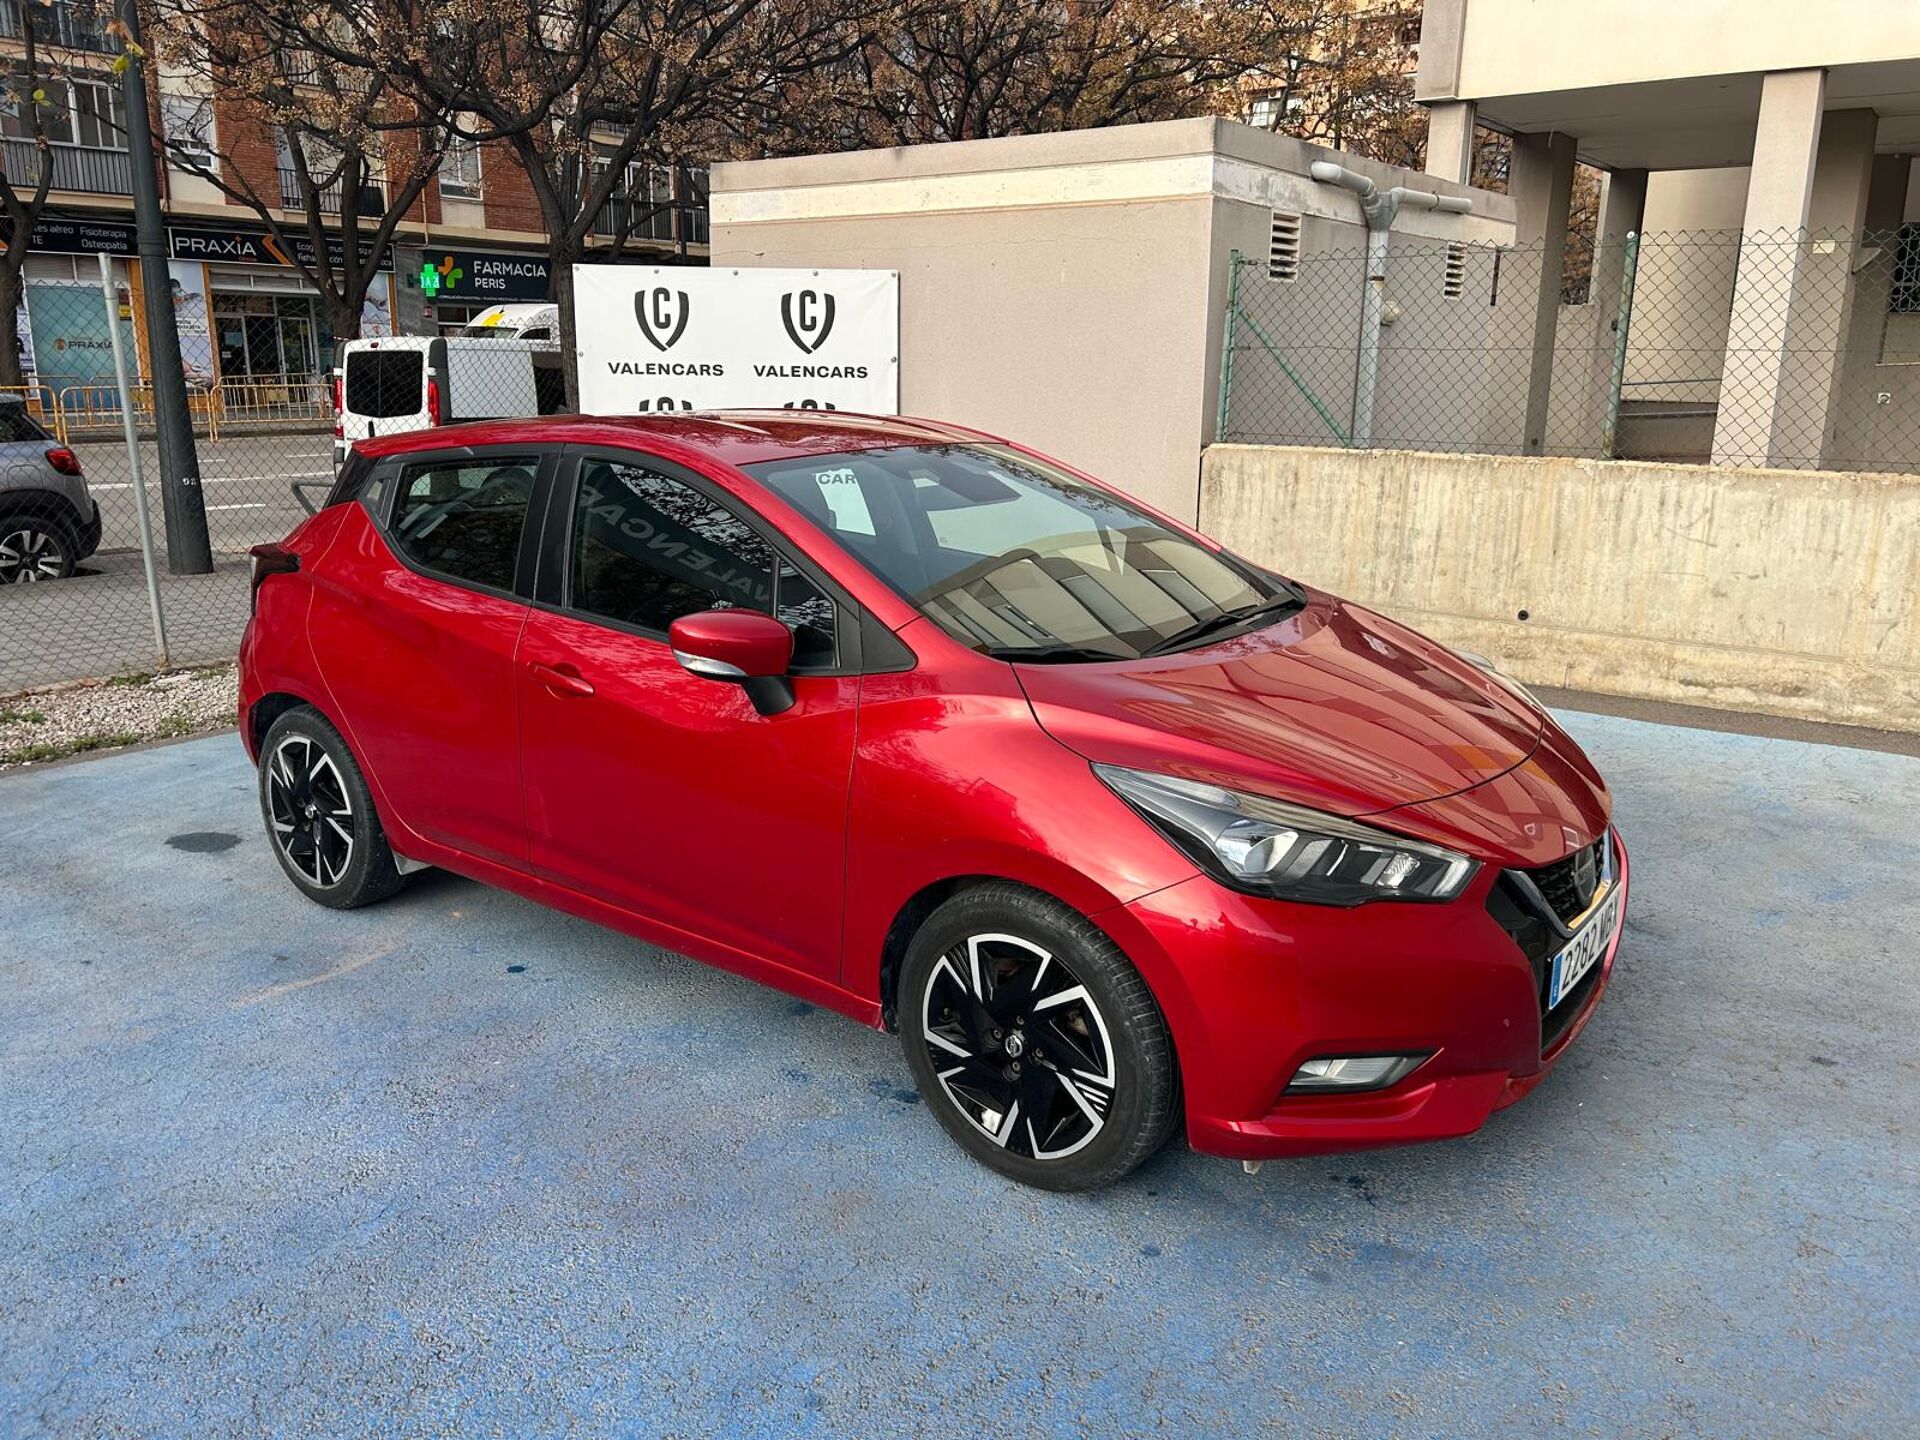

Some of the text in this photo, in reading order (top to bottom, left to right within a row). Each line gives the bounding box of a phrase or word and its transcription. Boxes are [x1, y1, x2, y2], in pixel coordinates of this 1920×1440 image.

[80, 226, 127, 239] Fisioterapia
[473, 260, 547, 278] FARMACIA
[474, 277, 506, 290] PERIS
[607, 362, 724, 377] VALENCARS
[753, 365, 869, 379] VALENCARS
[1562, 922, 1597, 992] 2282
